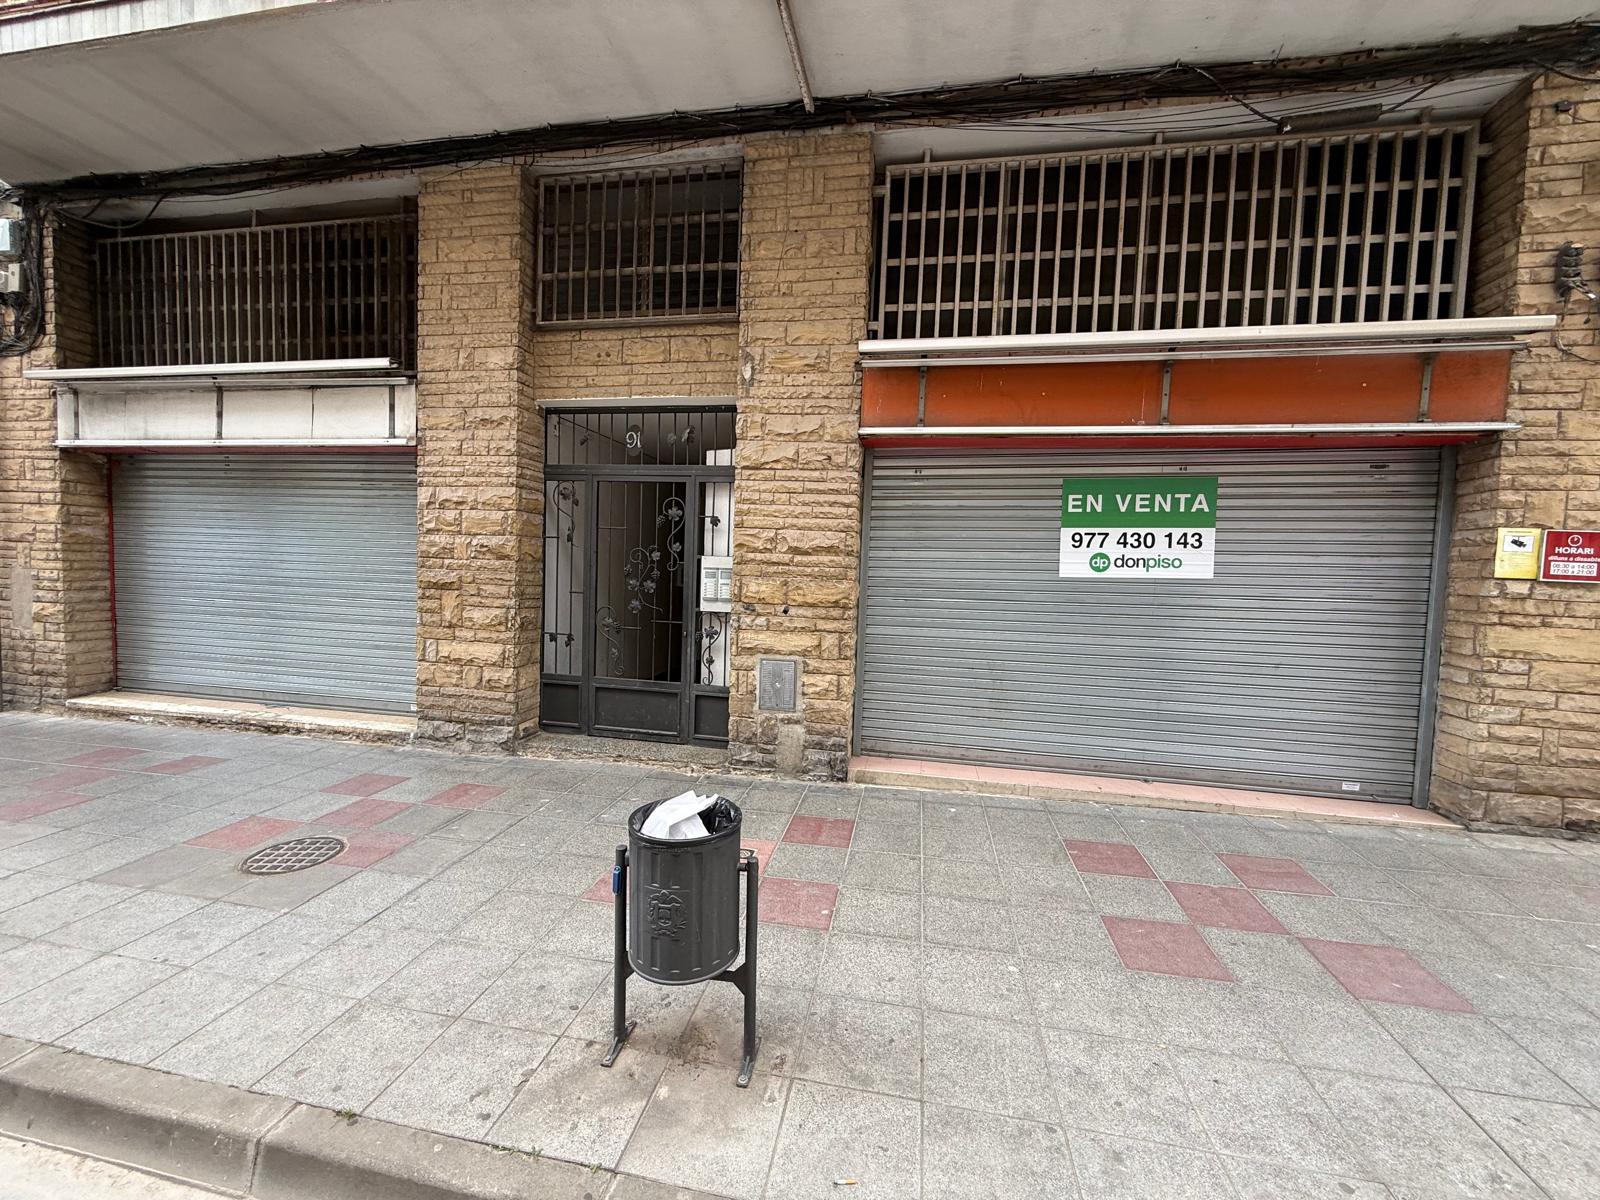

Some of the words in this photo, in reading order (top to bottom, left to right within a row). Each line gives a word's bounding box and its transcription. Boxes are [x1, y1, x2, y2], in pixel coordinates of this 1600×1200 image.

[625, 431, 642, 448] 91
[1067, 494, 1103, 513] EN
[1115, 493, 1210, 513] VENTA
[1071, 532, 1110, 549] 977
[1116, 532, 1156, 549] 430
[1164, 532, 1203, 549] 143
[1555, 546, 1594, 555] HORARI
[1091, 556, 1109, 569] dp
[1114, 554, 1183, 572] donpiso
